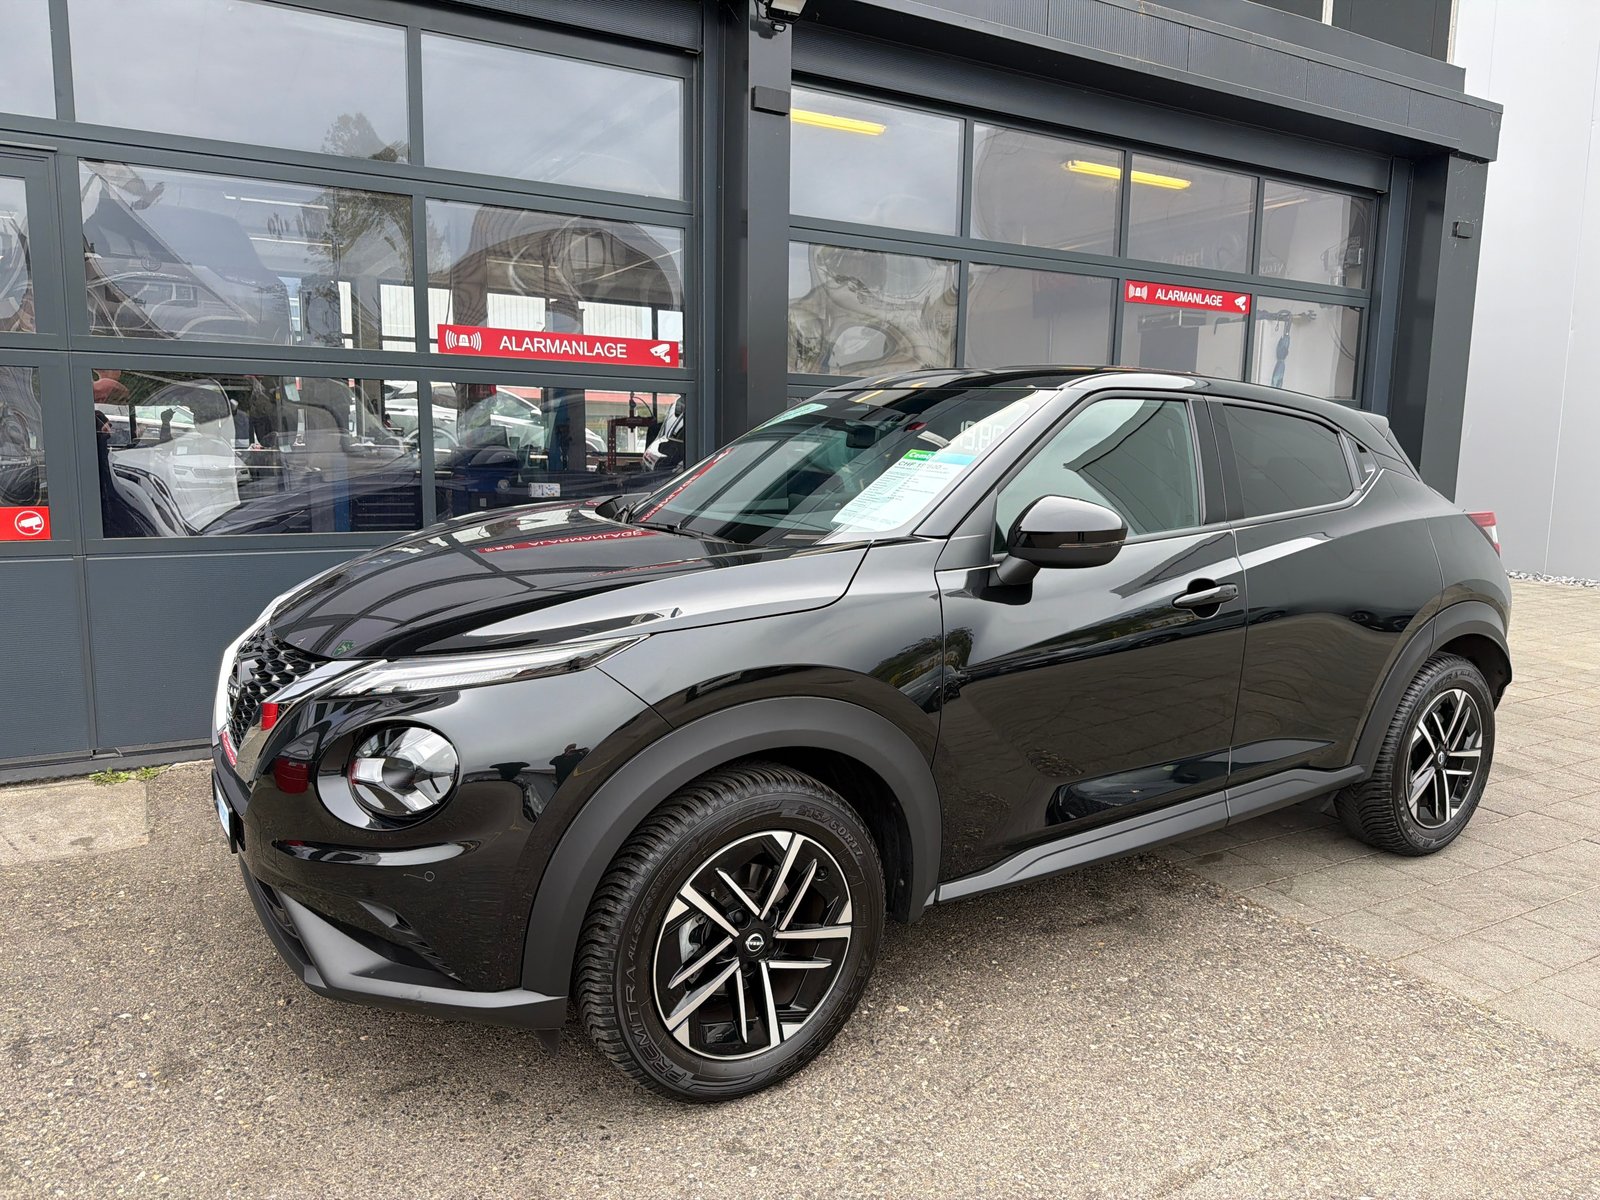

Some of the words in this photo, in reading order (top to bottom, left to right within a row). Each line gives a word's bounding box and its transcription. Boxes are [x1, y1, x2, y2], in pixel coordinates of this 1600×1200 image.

[1155, 288, 1223, 306] ALARMANLAGE
[500, 335, 627, 358] ALARMANLAGE
[625, 963, 688, 1085] PREMITRA
